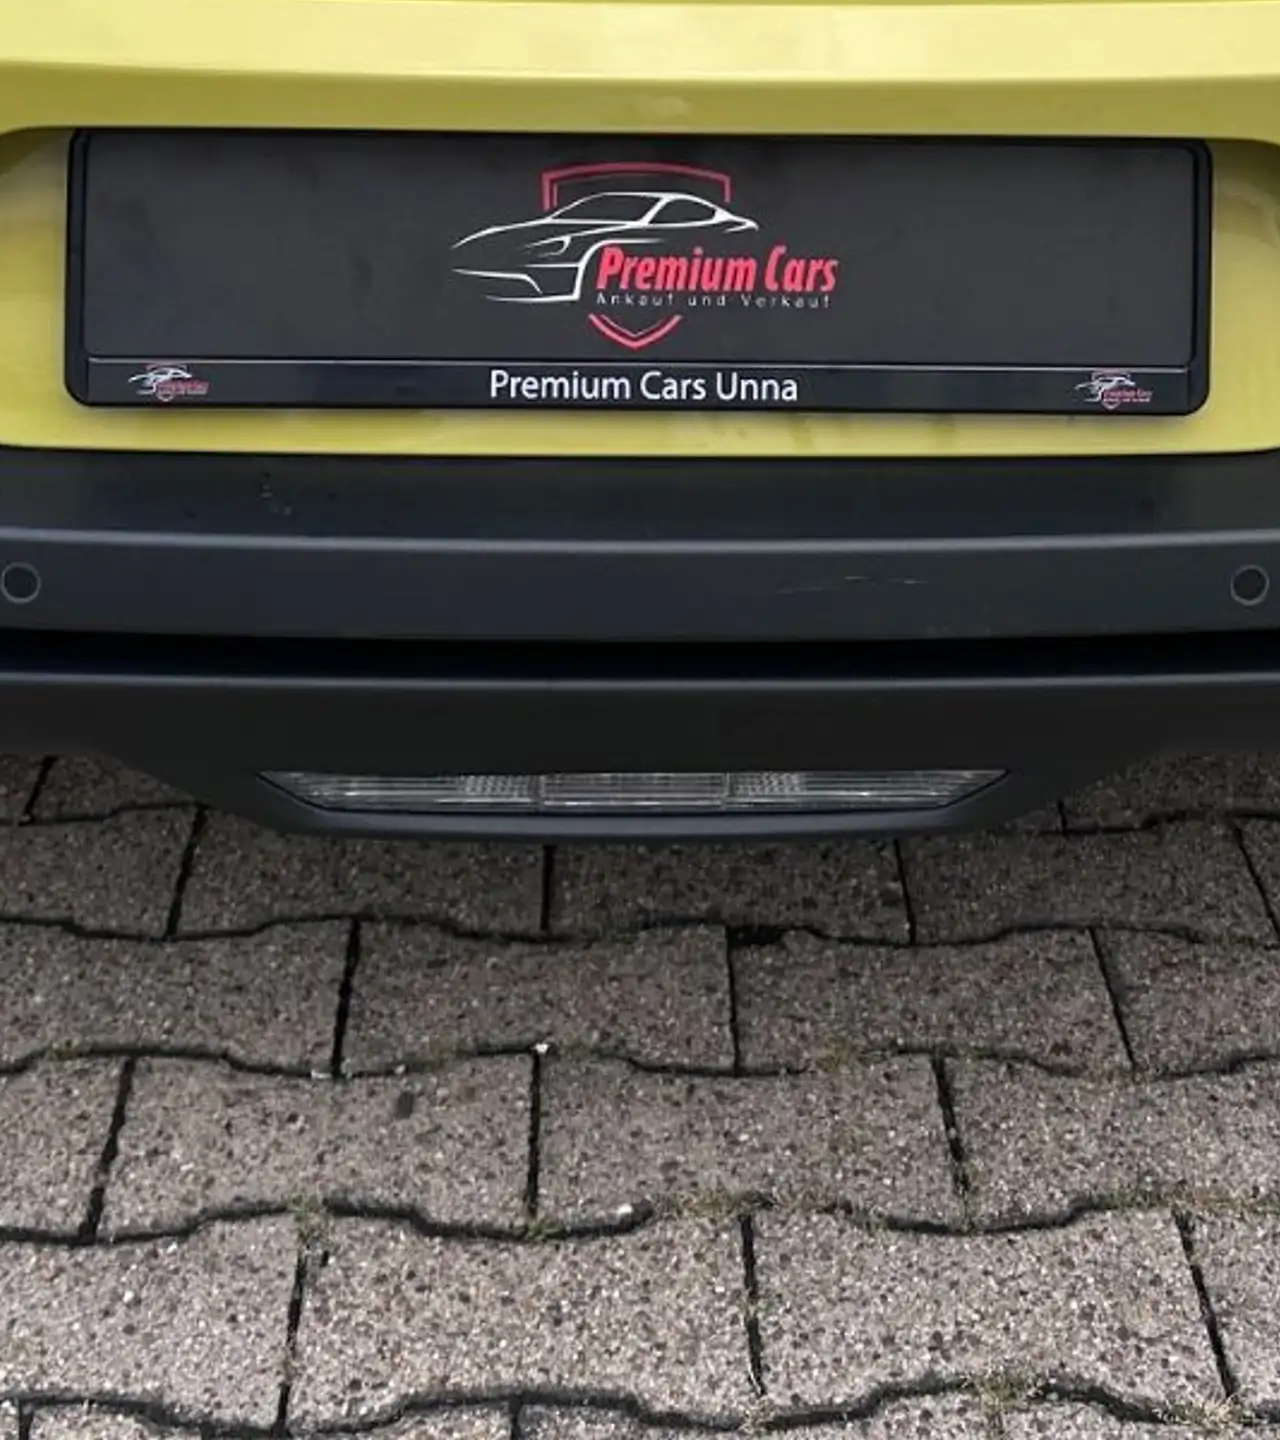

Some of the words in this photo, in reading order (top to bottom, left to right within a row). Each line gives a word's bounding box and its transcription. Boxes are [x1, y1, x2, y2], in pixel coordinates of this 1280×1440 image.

[596, 245, 757, 293] Premium
[764, 244, 839, 293] Cars
[596, 291, 675, 306] Ankauf
[687, 292, 727, 307] und
[741, 293, 832, 309] Verkauf
[489, 369, 632, 400] Premium
[640, 370, 707, 401] Cars
[716, 371, 799, 402] Unna
